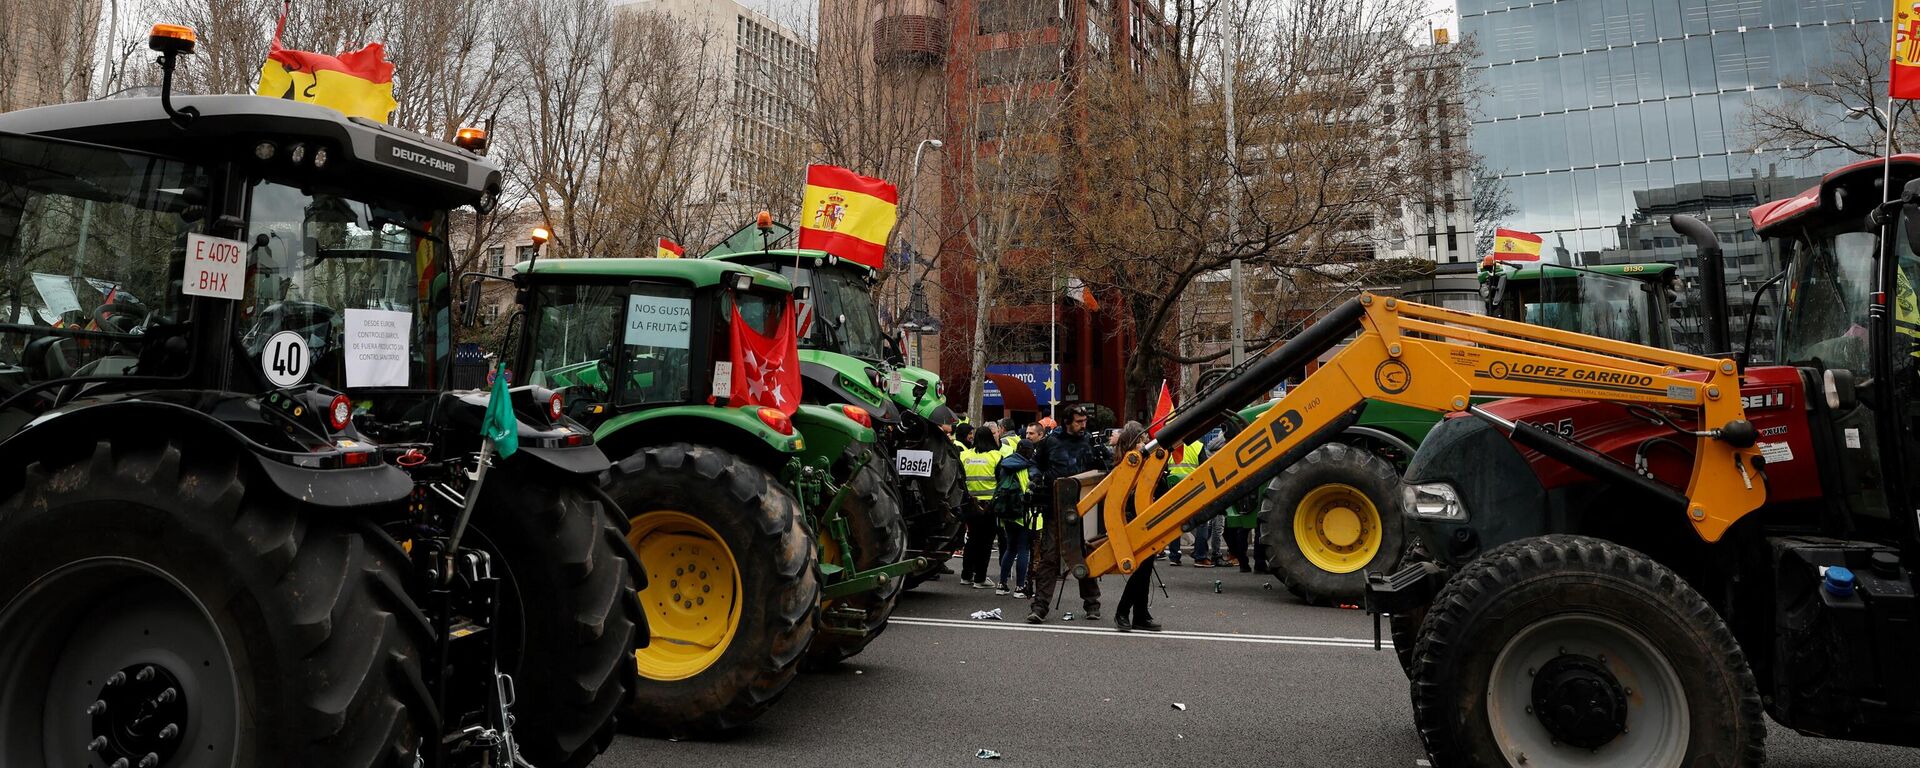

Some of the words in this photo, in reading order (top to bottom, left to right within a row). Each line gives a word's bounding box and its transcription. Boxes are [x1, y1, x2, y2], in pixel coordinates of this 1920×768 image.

[392, 146, 456, 173] DEUTZ-FAHR
[196, 241, 205, 260] E
[208, 242, 240, 264] 4079
[199, 270, 228, 292] BHX
[635, 304, 656, 314] NOS
[658, 305, 690, 316] GUSTA
[632, 321, 644, 330] LA
[646, 321, 678, 332] FRUTA
[272, 341, 301, 376] 40
[1511, 363, 1568, 378] LOPEZ
[1572, 369, 1653, 386] GARRIDO
[1304, 397, 1321, 413] 1400
[900, 456, 932, 473] Basta!
